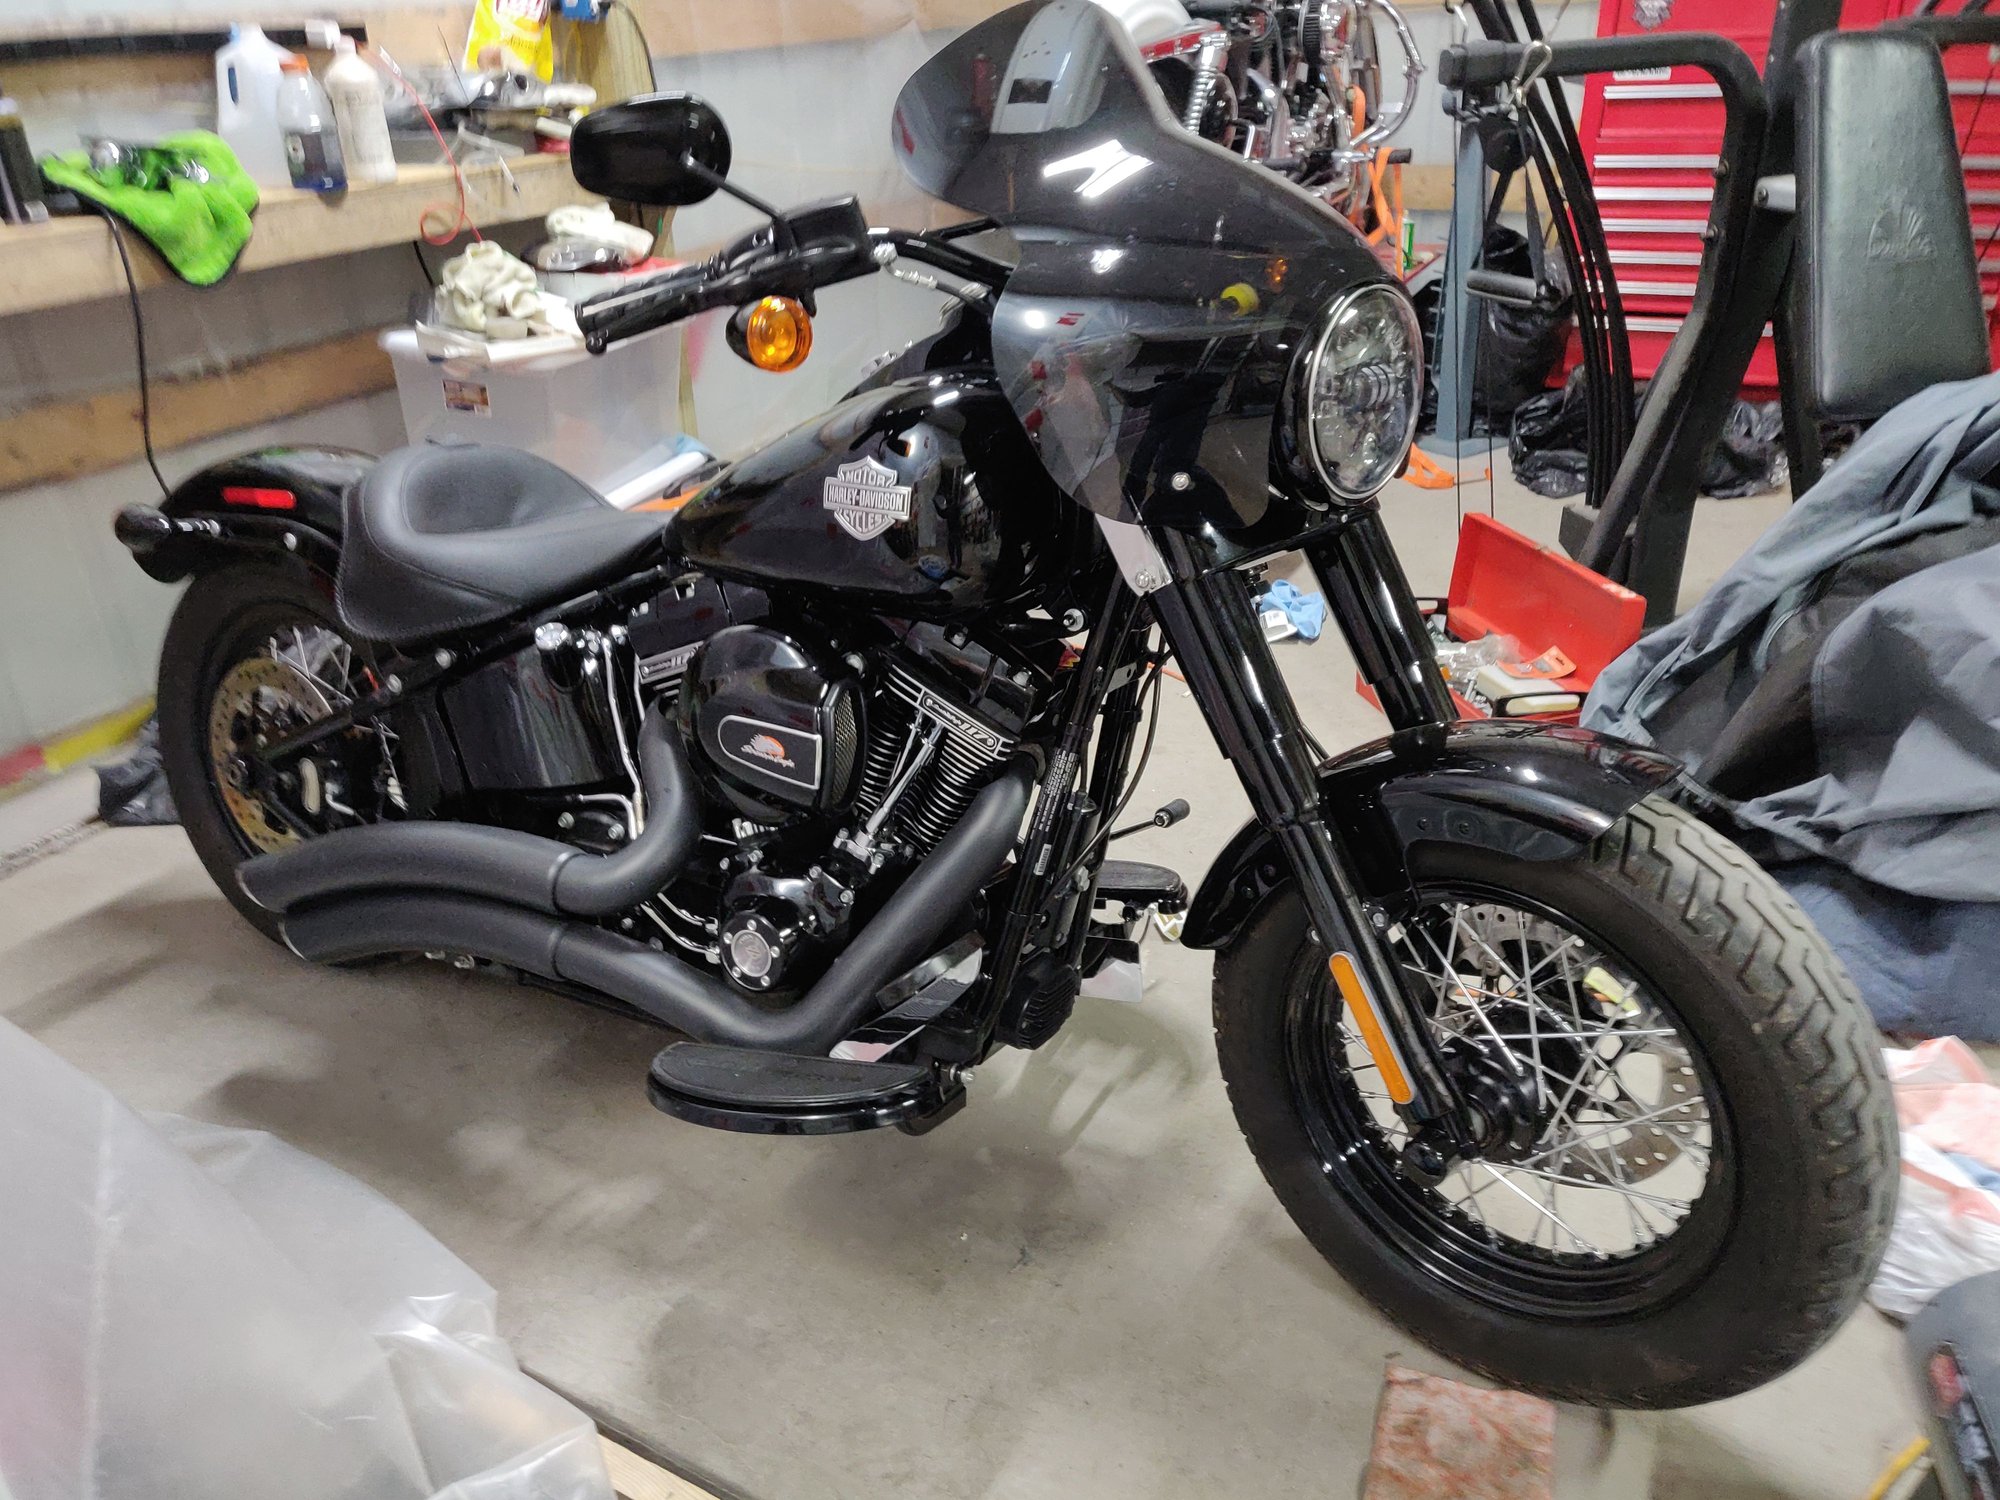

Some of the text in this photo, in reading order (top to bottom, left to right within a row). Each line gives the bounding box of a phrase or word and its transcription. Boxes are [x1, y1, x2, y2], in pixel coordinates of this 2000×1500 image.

[845, 466, 886, 487] MOTOR
[828, 484, 904, 511] HARLEY-DAVIDSON
[959, 722, 990, 739] 117
